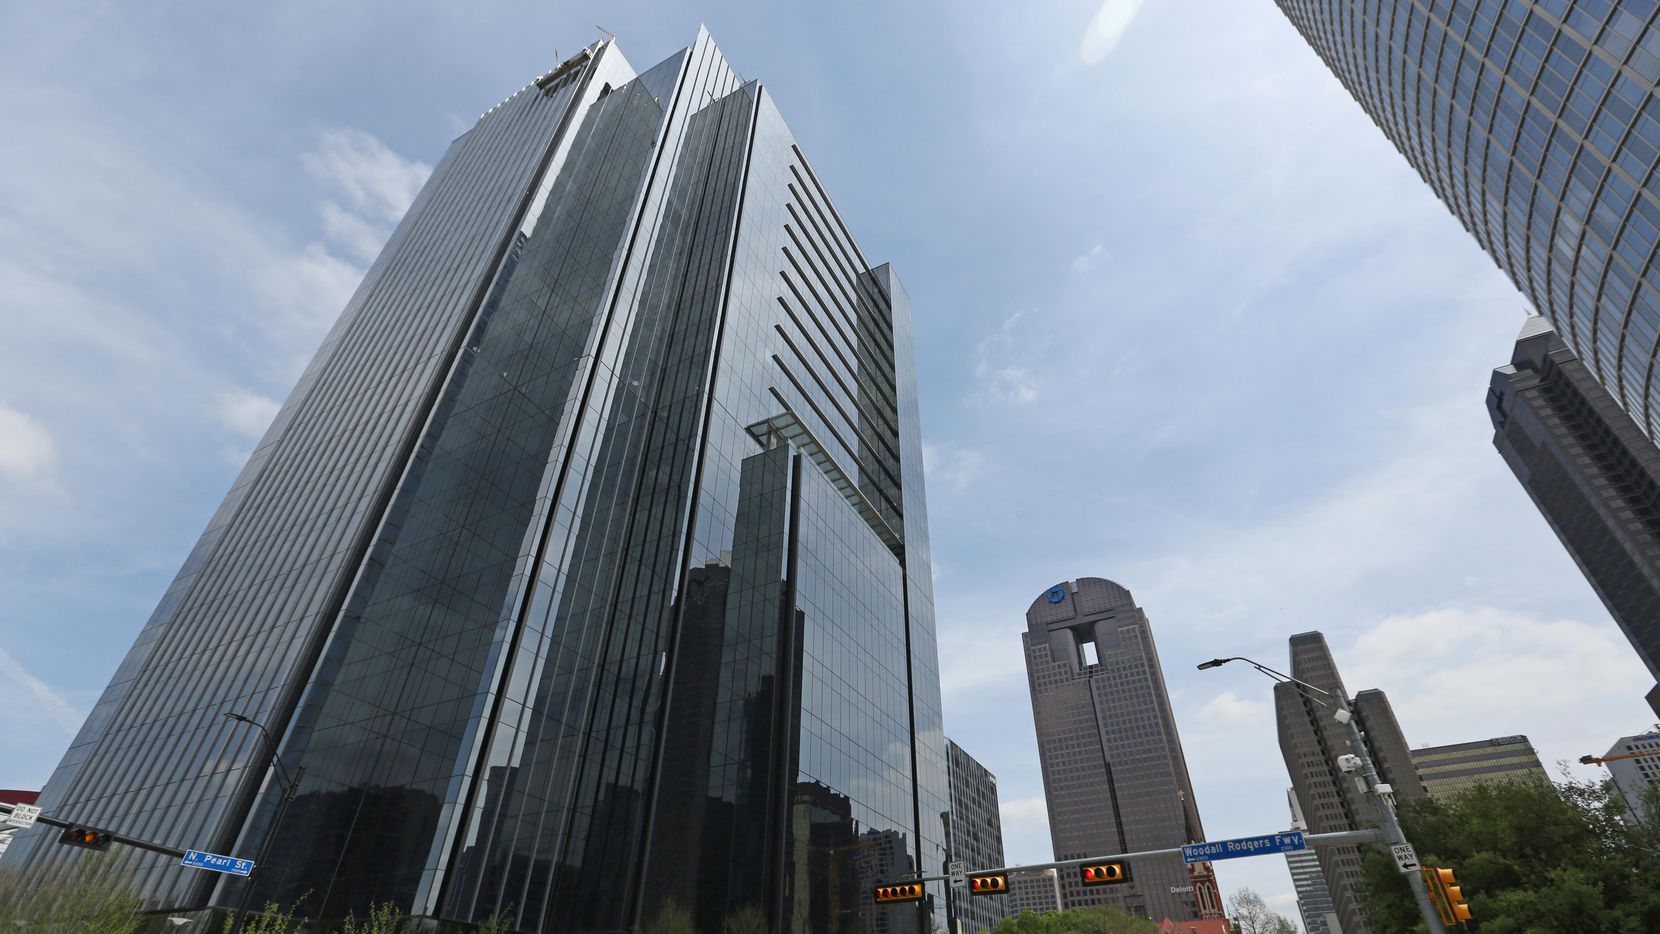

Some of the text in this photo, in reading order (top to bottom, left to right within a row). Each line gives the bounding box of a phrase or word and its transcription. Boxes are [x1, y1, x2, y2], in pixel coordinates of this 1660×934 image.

[13, 812, 32, 821] BLOCK
[1184, 843, 1223, 857] Woodall
[1227, 839, 1271, 852] Rodgers
[1394, 845, 1411, 854] ONE
[188, 852, 198, 861] N.
[204, 855, 231, 867] Pearl
[234, 860, 247, 870] St.
[1396, 853, 1413, 861] WAY
[1170, 885, 1194, 894] Deloitt
